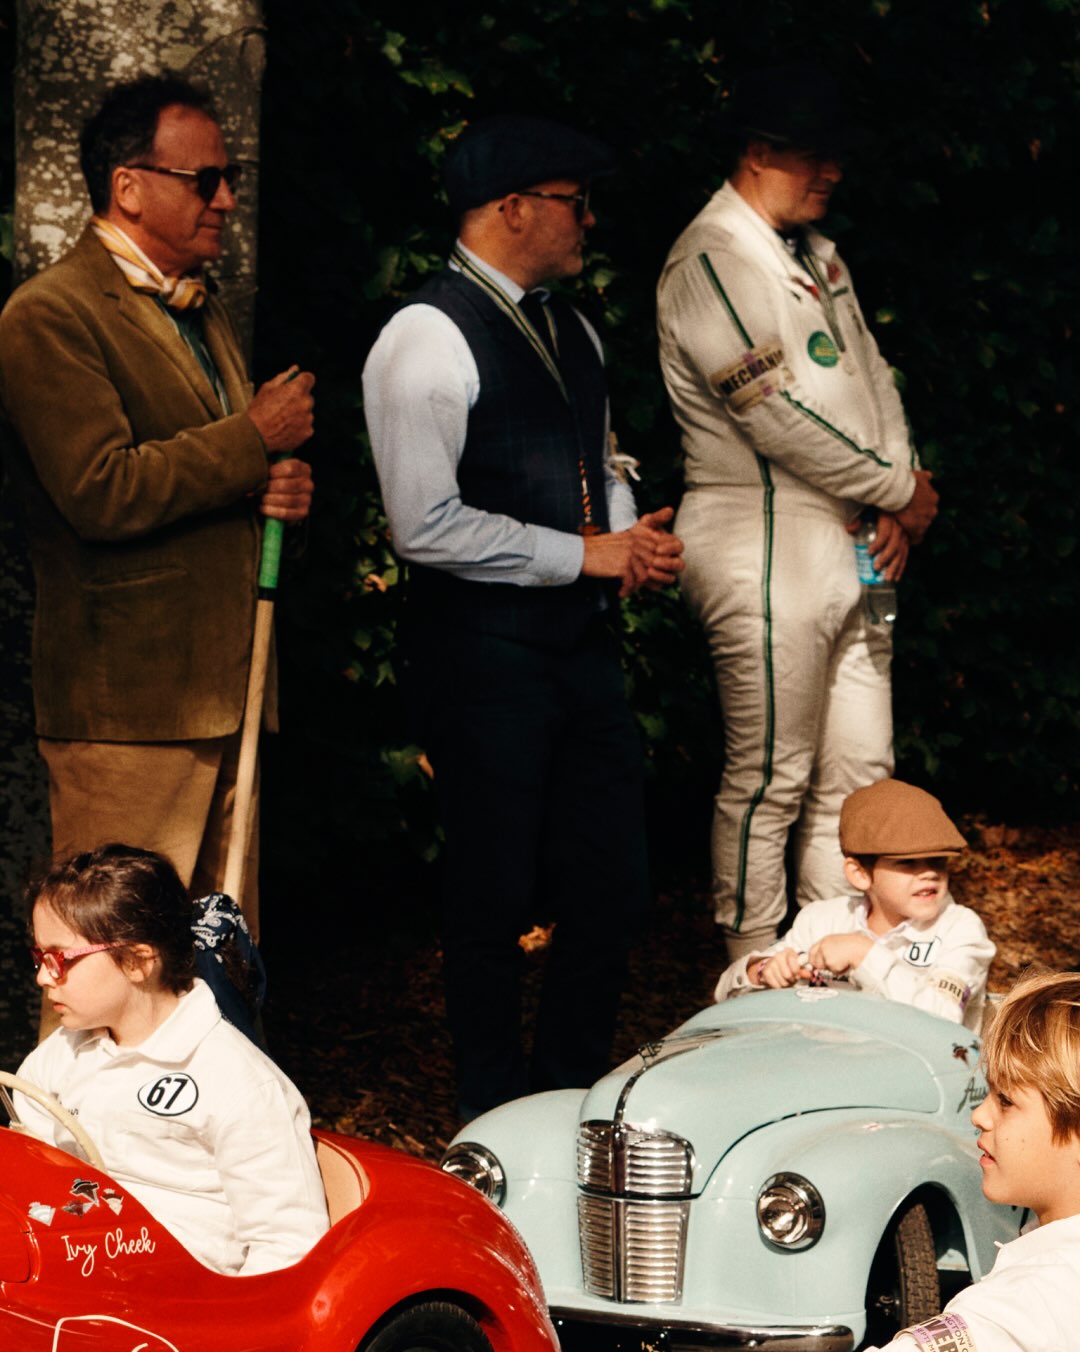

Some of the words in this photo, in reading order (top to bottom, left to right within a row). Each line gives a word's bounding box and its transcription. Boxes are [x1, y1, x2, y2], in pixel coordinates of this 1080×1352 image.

[147, 1076, 189, 1110] 67
[61, 1235, 98, 1277] Ivy
[105, 1226, 156, 1259] Cheek
